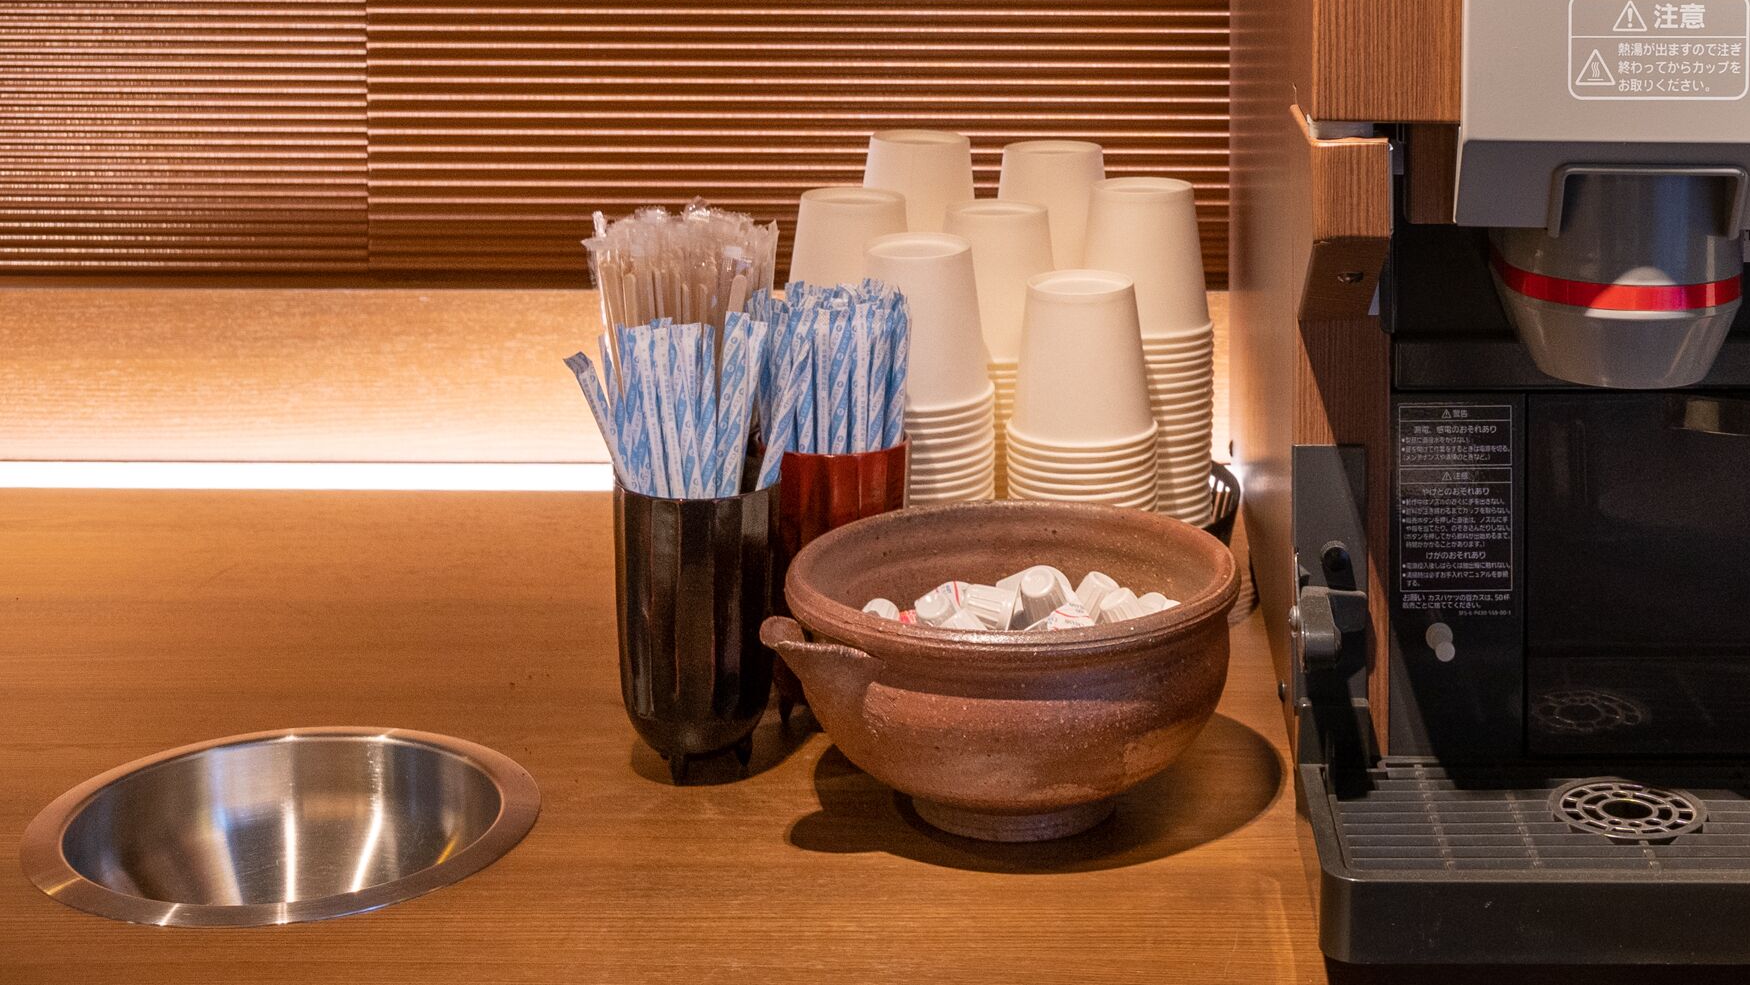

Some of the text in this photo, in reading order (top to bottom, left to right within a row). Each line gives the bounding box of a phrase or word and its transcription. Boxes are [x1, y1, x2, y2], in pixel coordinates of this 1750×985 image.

[1653, 3, 1706, 29] 注意
[1618, 42, 1742, 57] 熱湯が出ますので注ぎ
[1618, 61, 1741, 74] 終わってからカップを
[1618, 79, 1711, 93] お取りください。
